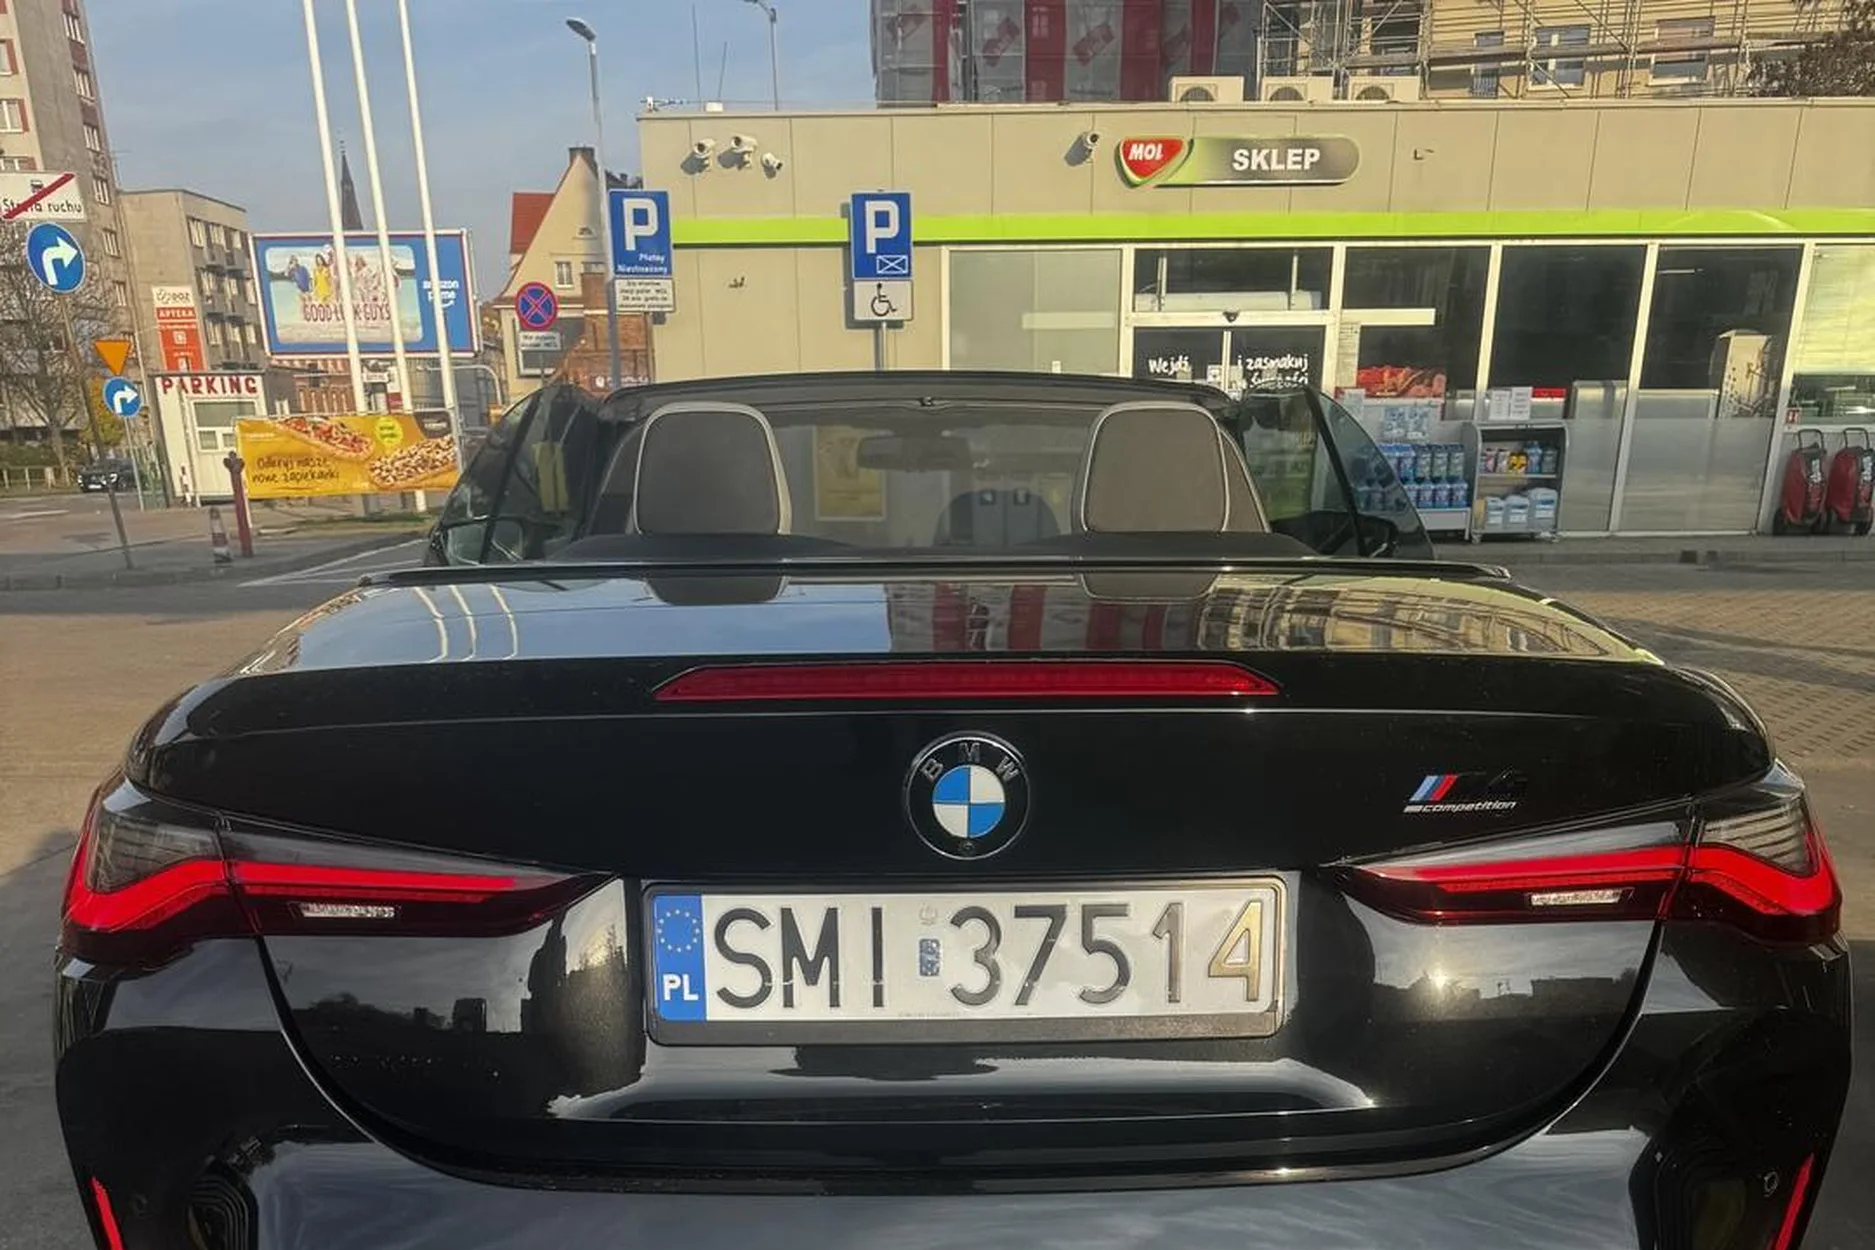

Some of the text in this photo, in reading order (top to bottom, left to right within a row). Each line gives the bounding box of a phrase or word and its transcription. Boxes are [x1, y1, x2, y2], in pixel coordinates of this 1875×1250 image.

[1128, 143, 1164, 160] MOL
[1232, 148, 1320, 171] SKLEP
[48, 200, 82, 213] ruchu
[622, 198, 658, 251] P
[865, 200, 899, 254] P
[303, 302, 332, 322] GOOD
[1246, 353, 1308, 372] zasmakuj
[919, 742, 1021, 783] BMW
[1422, 800, 1518, 814] competition
[713, 900, 1263, 1009] SMI 37514
[663, 973, 699, 1002] PL
